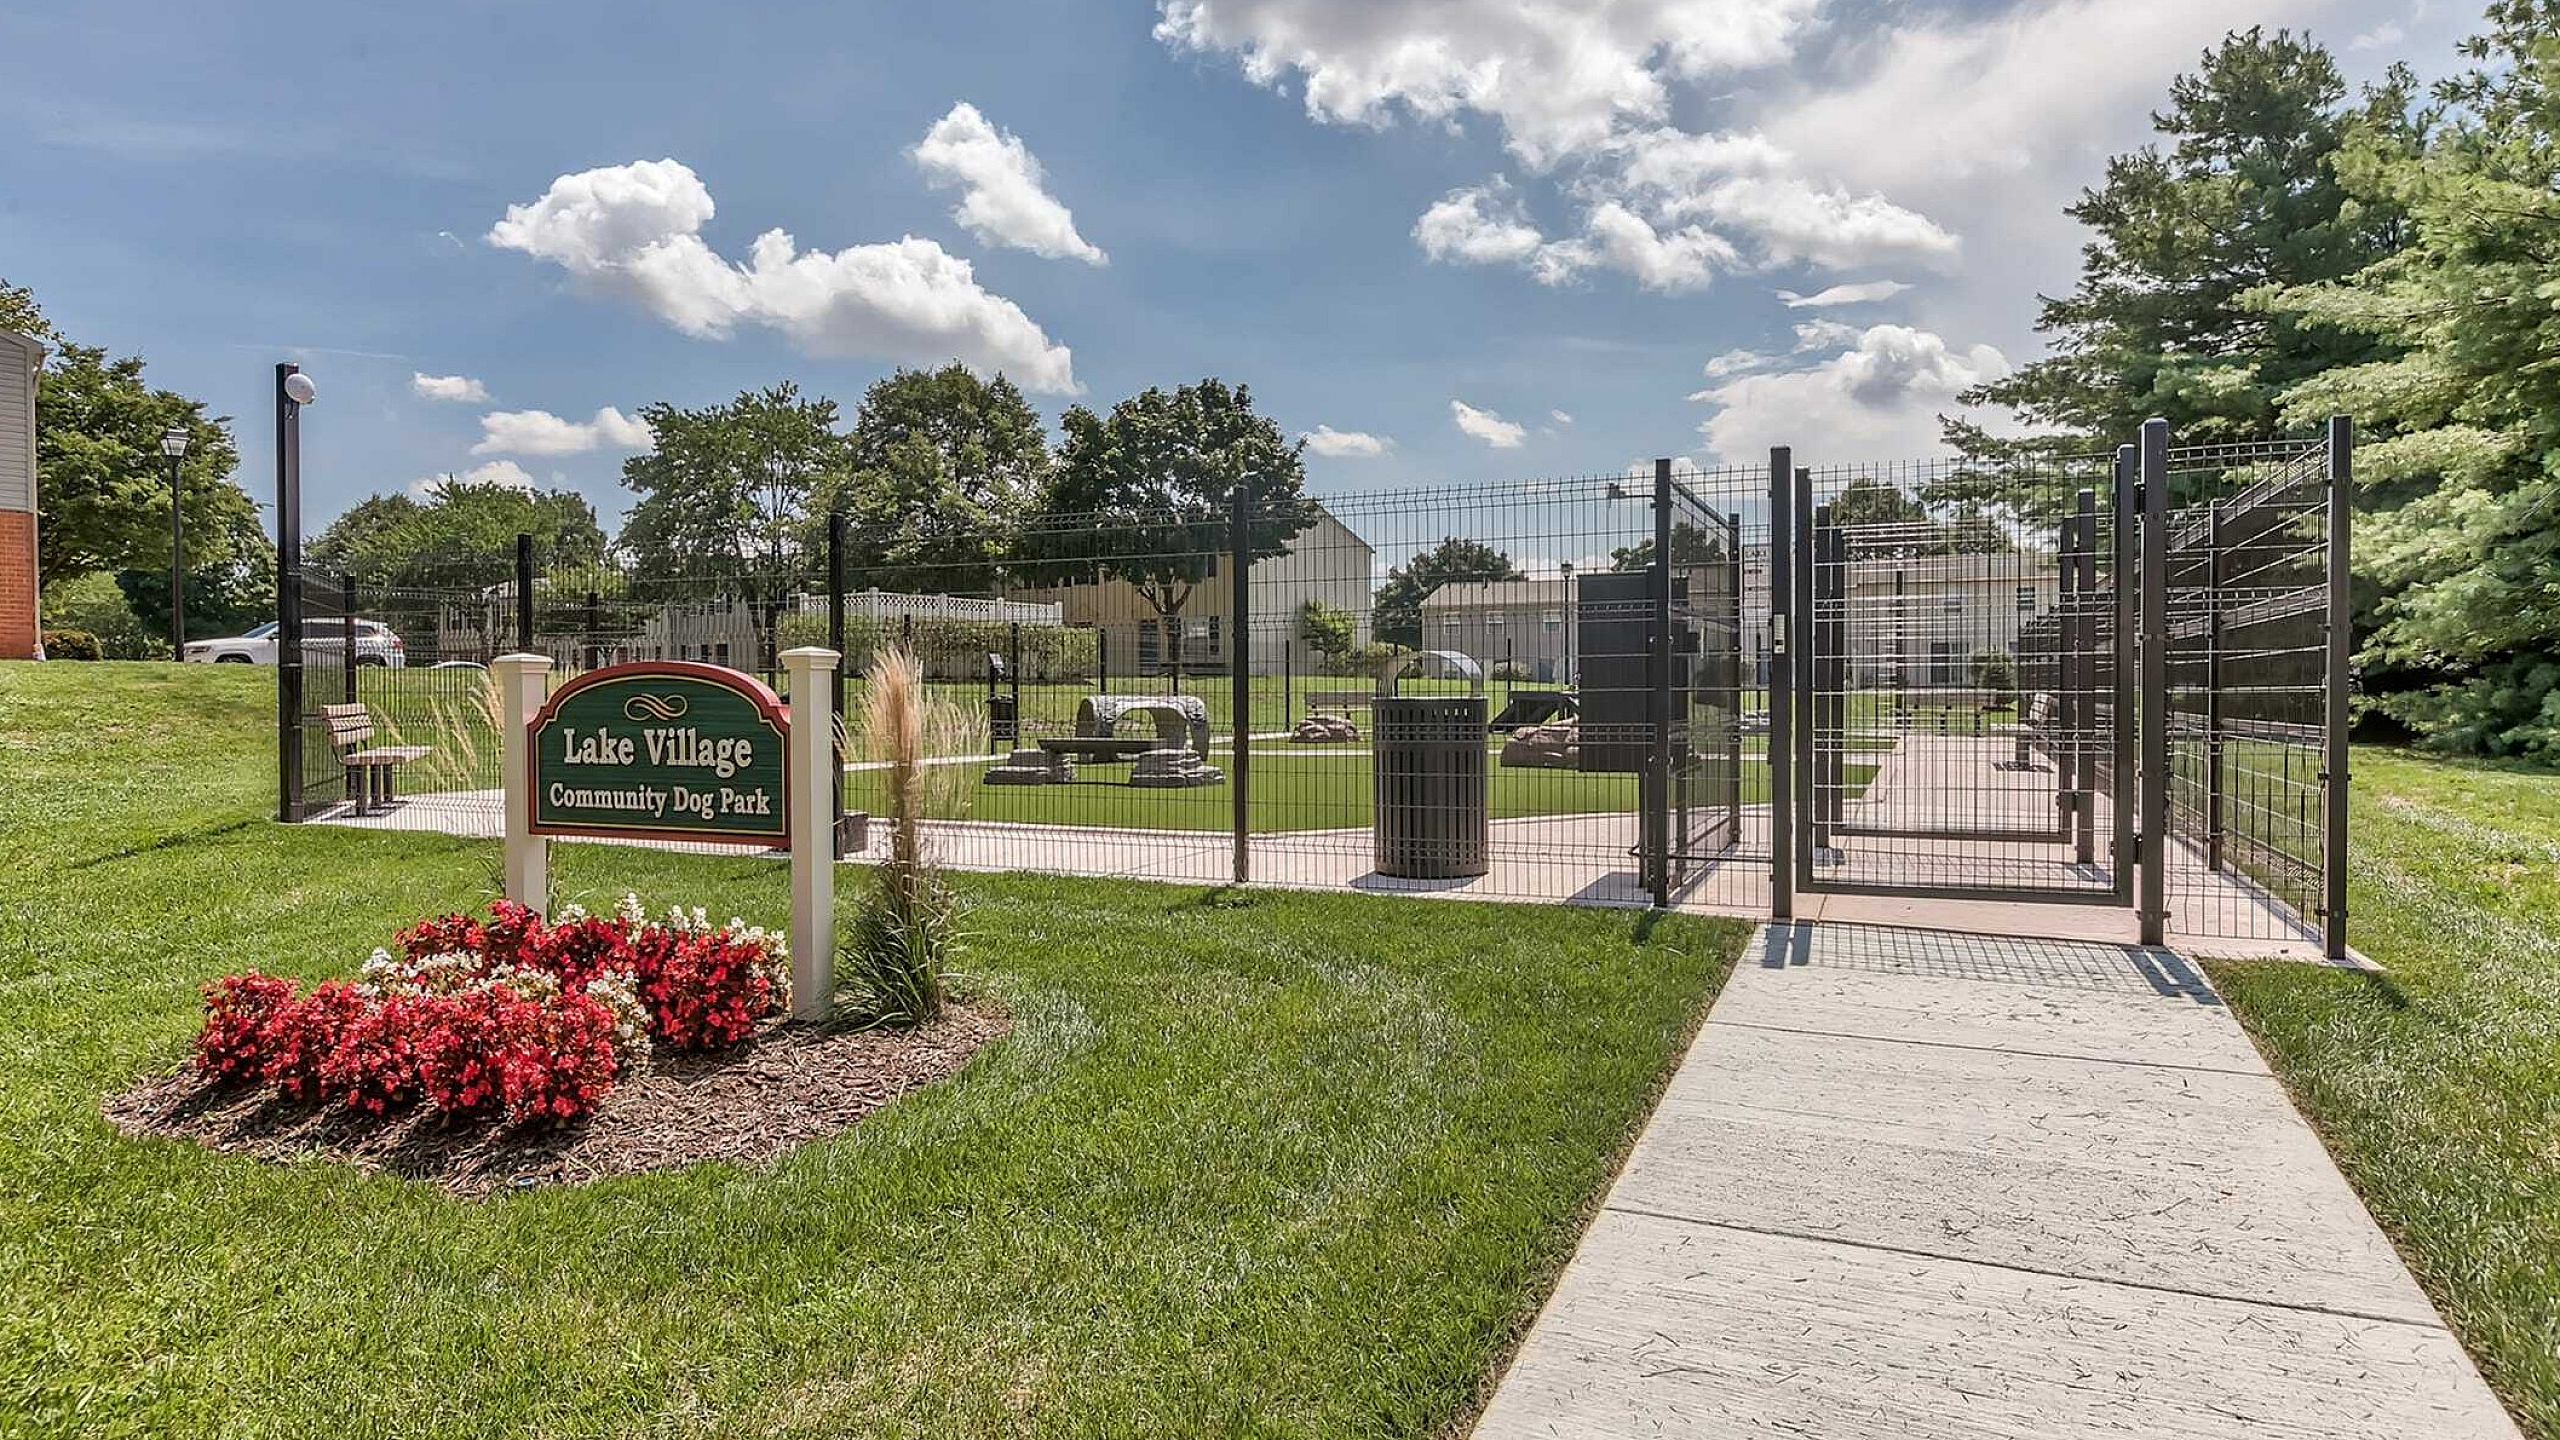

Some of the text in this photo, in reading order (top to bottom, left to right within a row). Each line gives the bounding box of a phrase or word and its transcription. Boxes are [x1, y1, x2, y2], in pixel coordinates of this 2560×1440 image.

[562, 727, 752, 779] Lake Village
[550, 782, 771, 819] Community Dog Park
